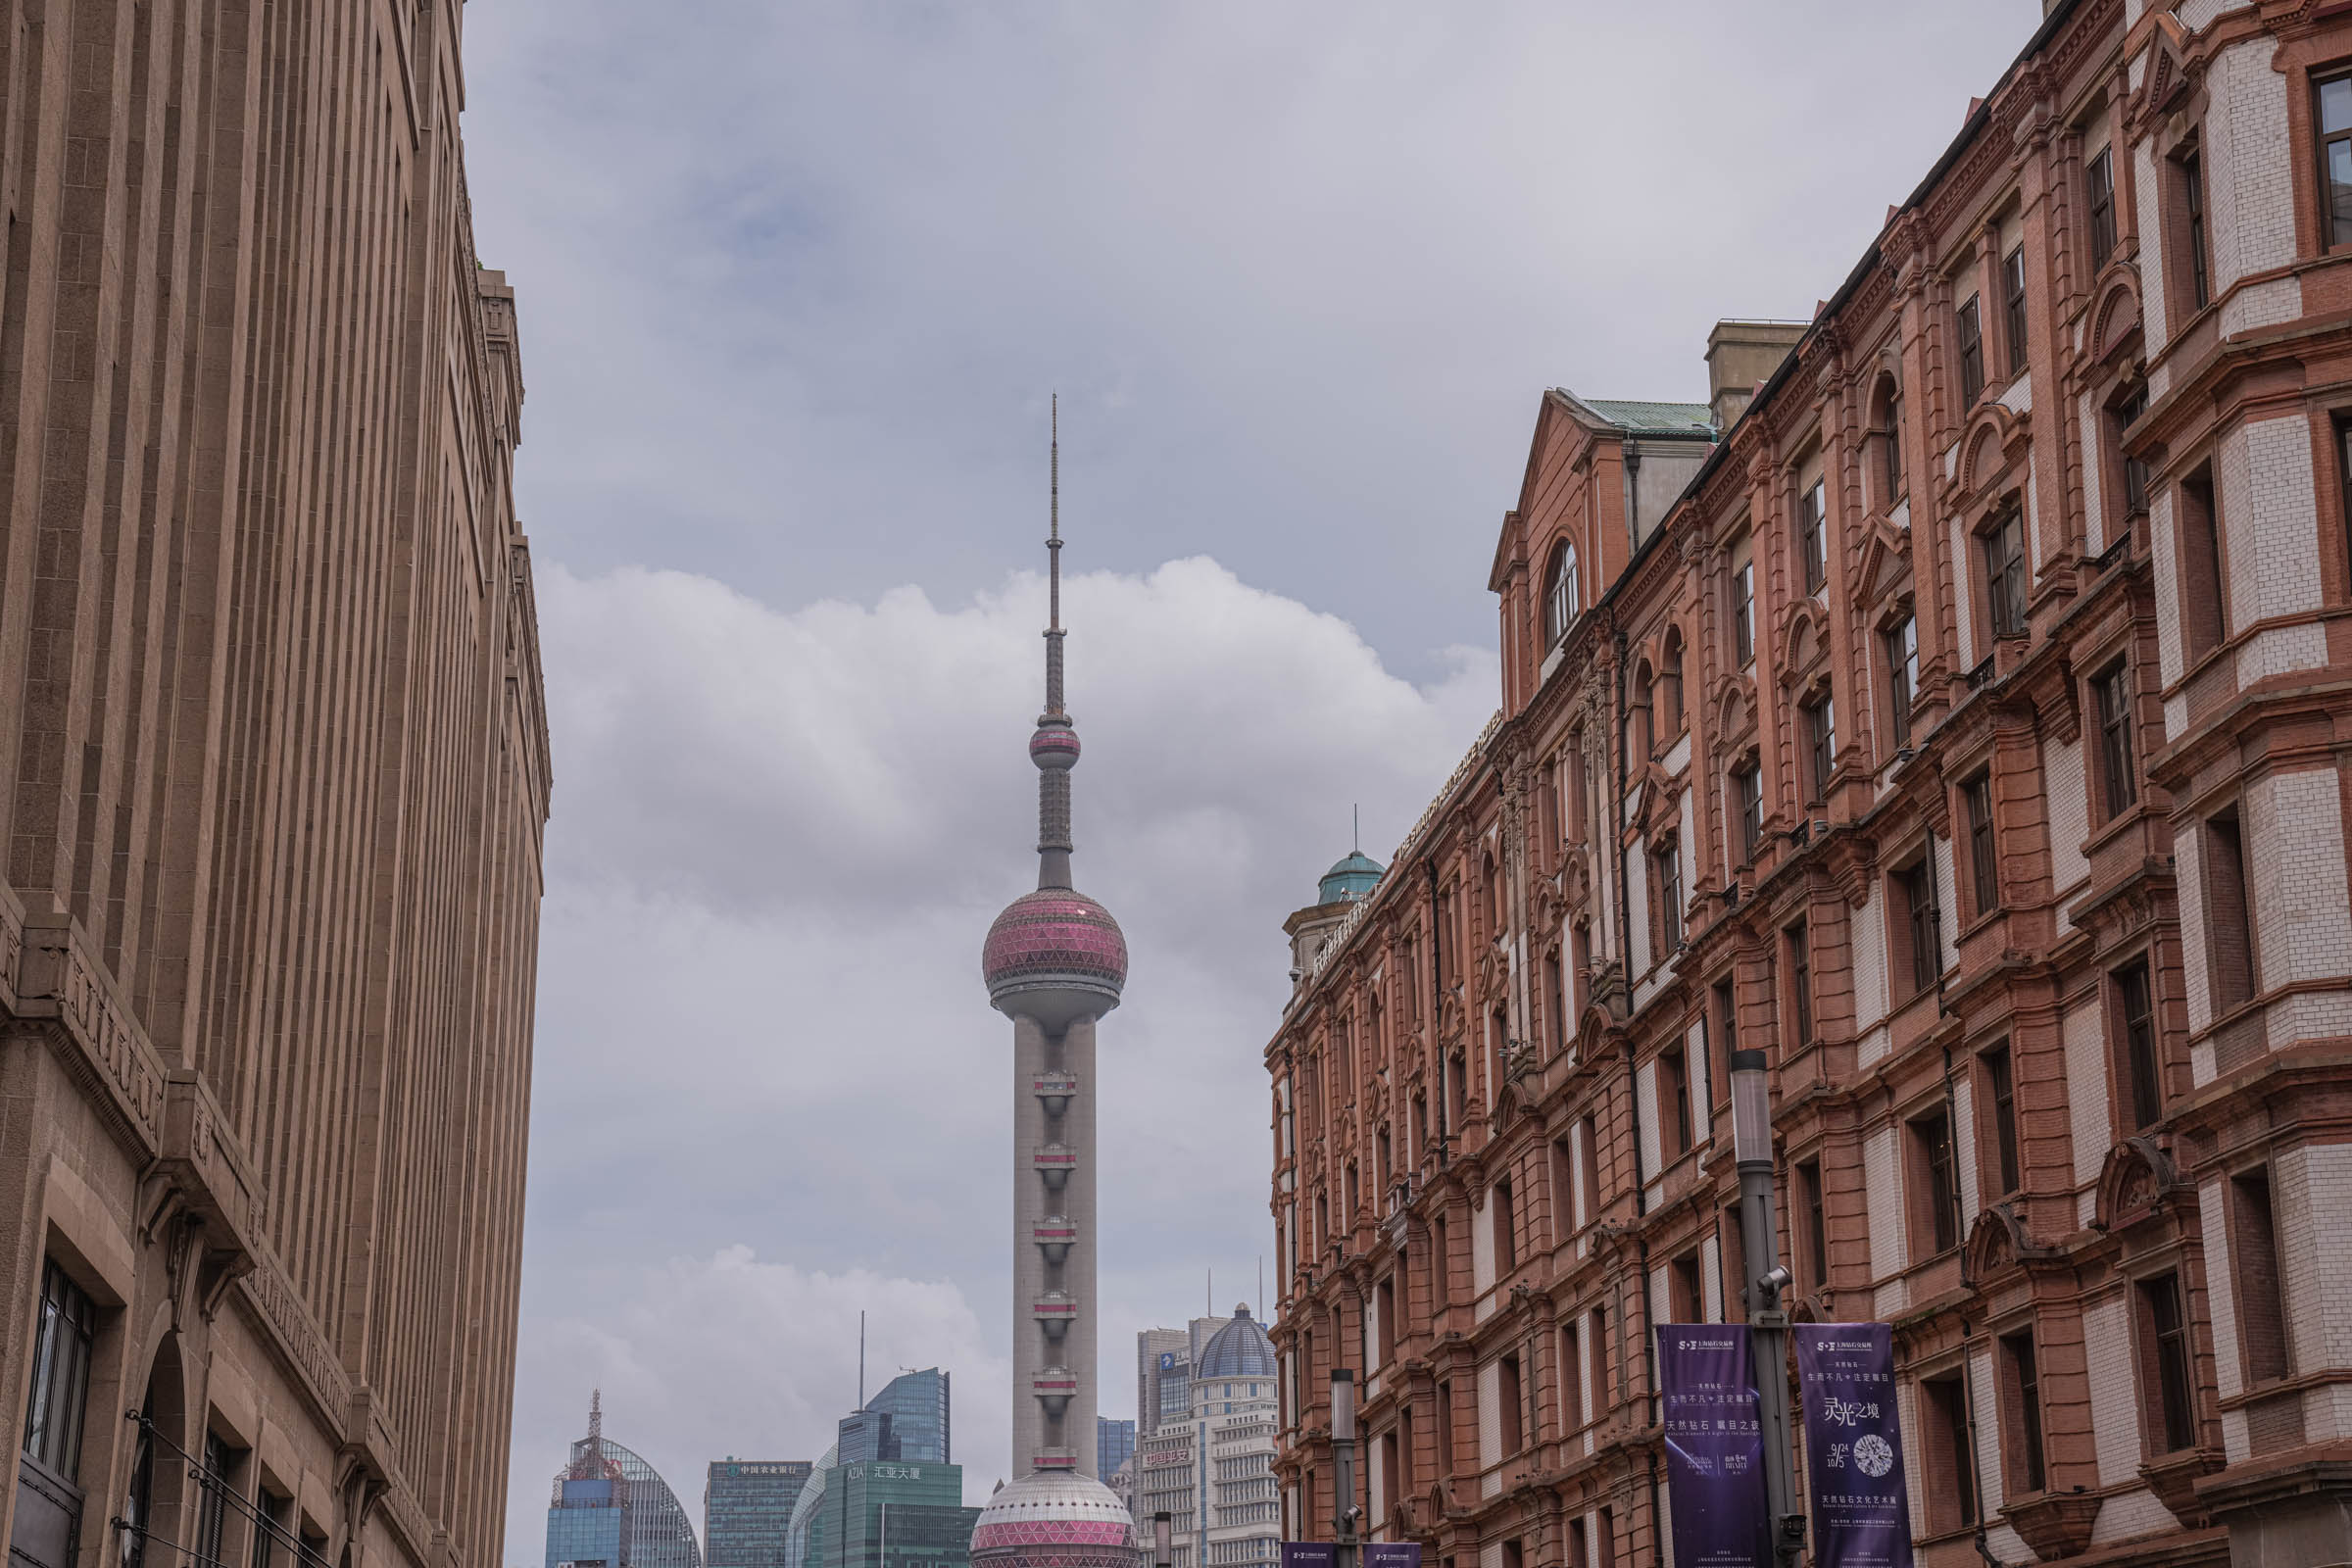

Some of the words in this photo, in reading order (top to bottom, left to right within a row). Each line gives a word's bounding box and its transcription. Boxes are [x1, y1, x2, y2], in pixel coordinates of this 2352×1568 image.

[1453, 742, 1477, 786] PEACE
[1478, 709, 1502, 752] HOTEL
[1824, 1396, 1880, 1427] 灵光之境
[1667, 1420, 1709, 1431] 天然钻石
[1717, 1419, 1760, 1431] 瞩目之夜
[1147, 1448, 1189, 1466] 中国平安
[741, 1465, 797, 1475] 中国农业银行
[847, 1465, 863, 1482] AZIA
[874, 1466, 921, 1480] 汇亚大厦
